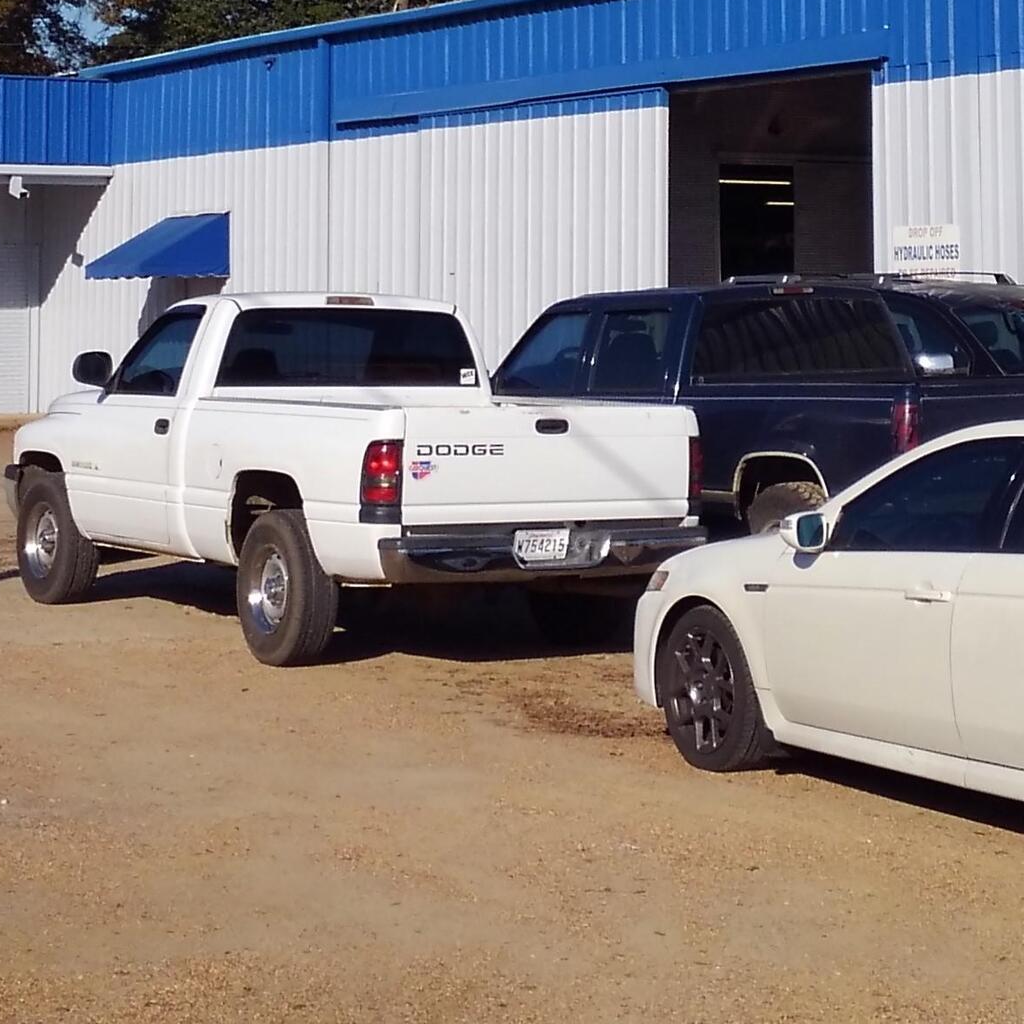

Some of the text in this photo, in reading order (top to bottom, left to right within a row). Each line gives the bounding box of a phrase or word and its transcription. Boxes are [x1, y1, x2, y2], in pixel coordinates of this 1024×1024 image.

[908, 226, 943, 238] DROP OFF
[894, 244, 959, 261] HYDRAULIC HOSES
[417, 444, 504, 456] DODGE
